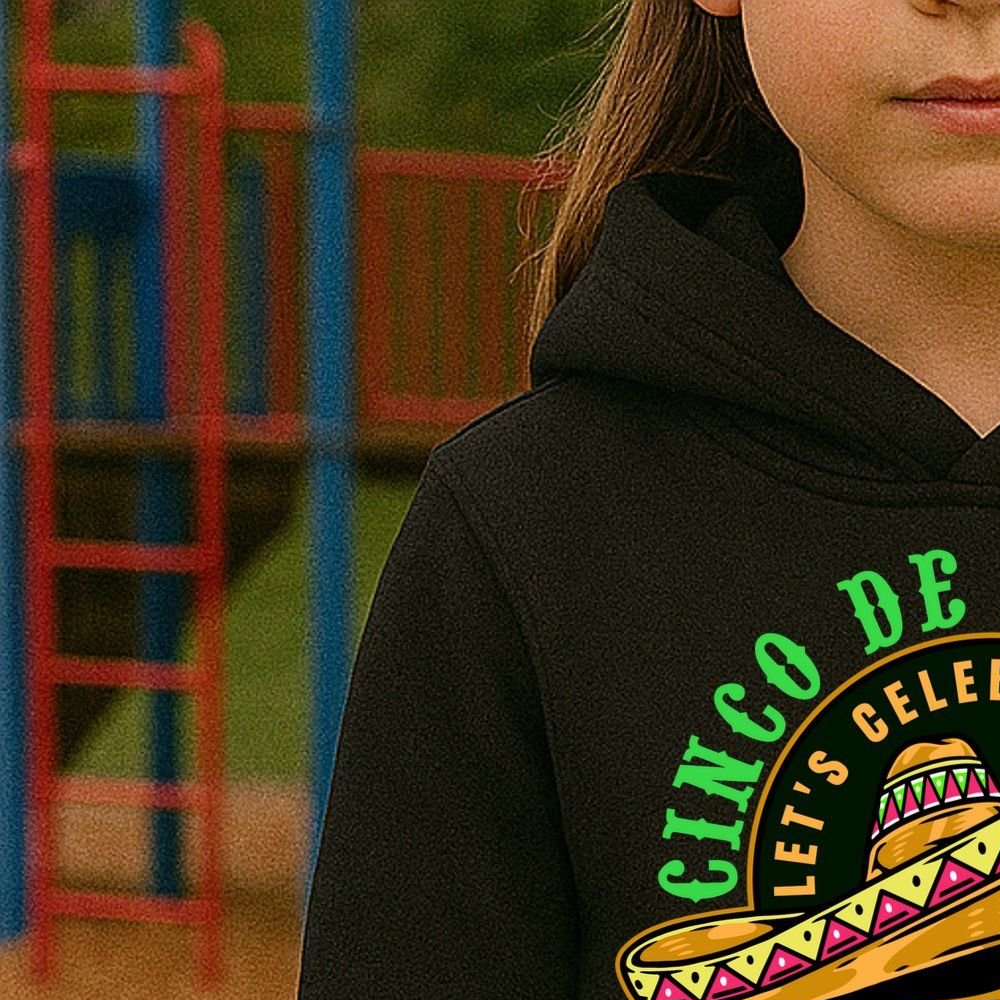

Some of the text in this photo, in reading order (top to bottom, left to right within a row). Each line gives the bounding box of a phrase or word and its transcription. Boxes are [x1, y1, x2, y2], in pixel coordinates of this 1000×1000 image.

[657, 632, 821, 903] CINCO
[836, 549, 966, 655] DE
[773, 751, 848, 896] LET'S
